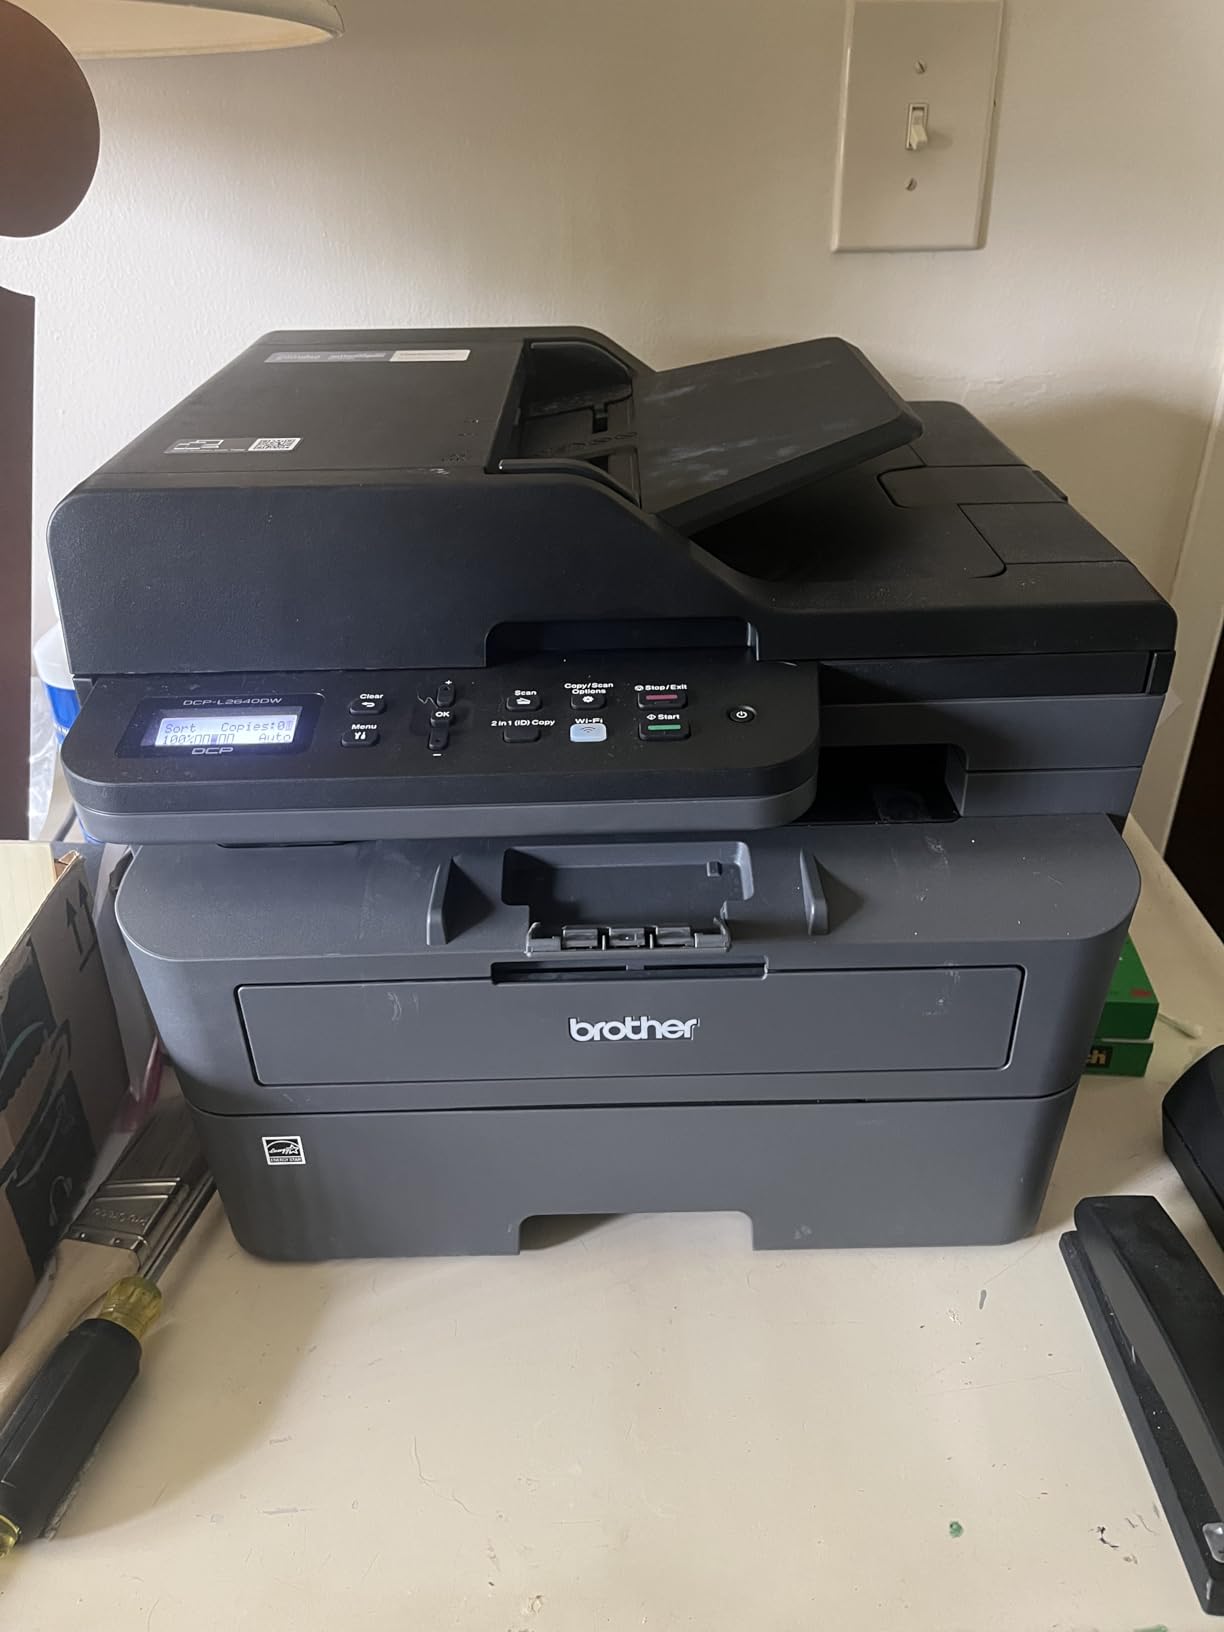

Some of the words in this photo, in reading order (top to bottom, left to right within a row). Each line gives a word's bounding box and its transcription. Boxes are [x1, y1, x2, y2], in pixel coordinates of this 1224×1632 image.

[564, 682, 614, 690] Copy/Scan
[183, 698, 282, 706] DCP-L2640DW
[514, 719, 530, 727] (ID)
[531, 719, 556, 727] Copy
[164, 723, 197, 734] Sort
[258, 732, 292, 742] Auto
[191, 747, 234, 755] DCP
[568, 1015, 699, 1042] brother
